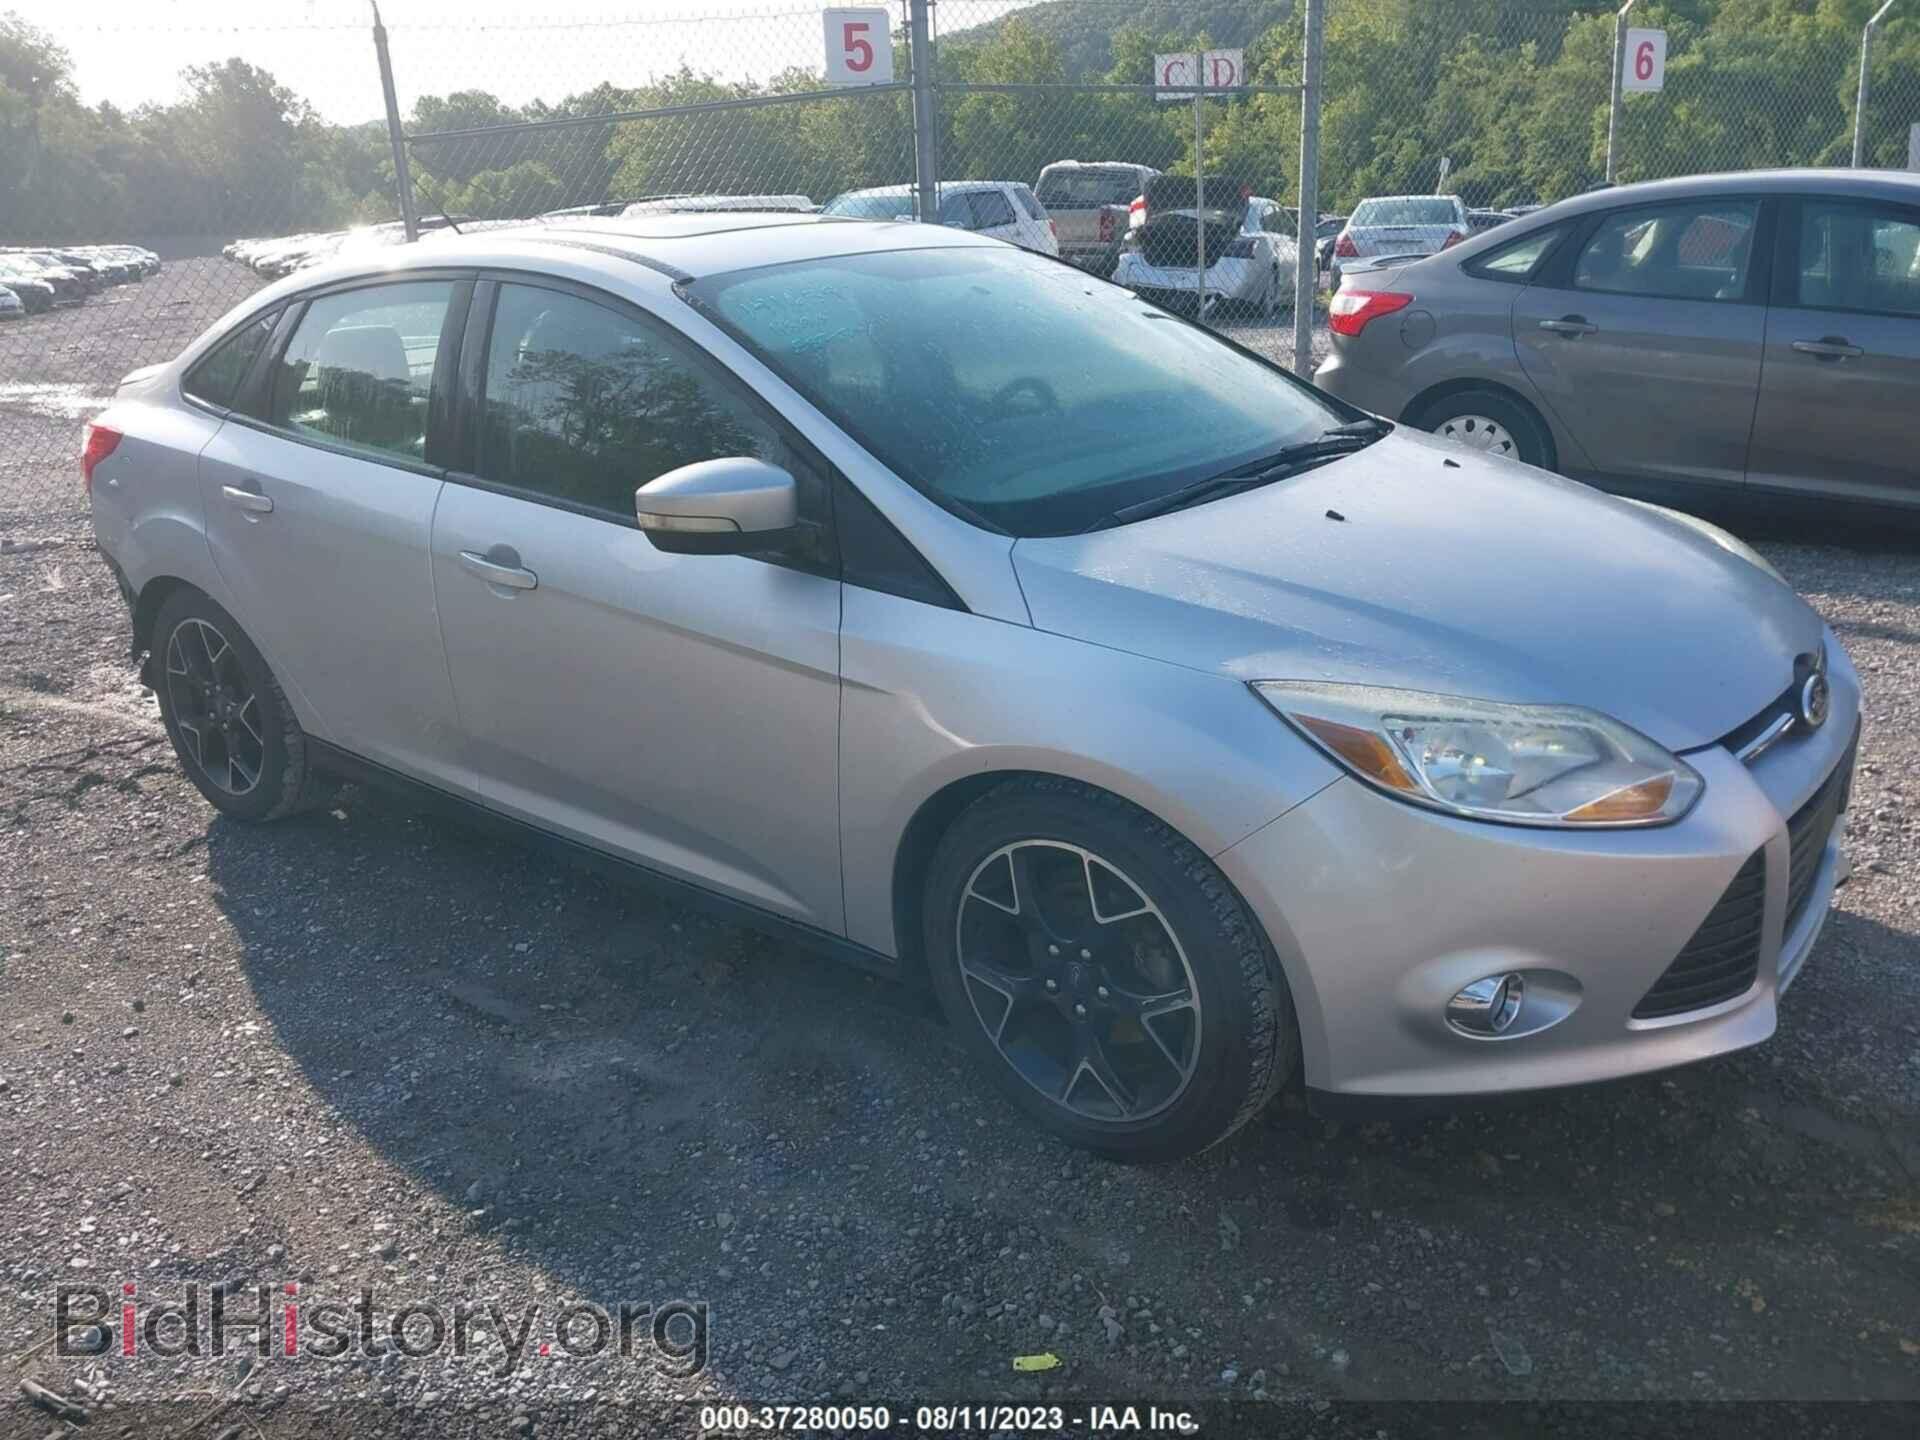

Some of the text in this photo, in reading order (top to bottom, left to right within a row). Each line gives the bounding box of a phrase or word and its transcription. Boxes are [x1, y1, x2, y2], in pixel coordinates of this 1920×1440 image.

[843, 22, 873, 72] 5
[1635, 40, 1655, 80] 6
[1163, 60, 1185, 87] C
[1211, 58, 1235, 87] D
